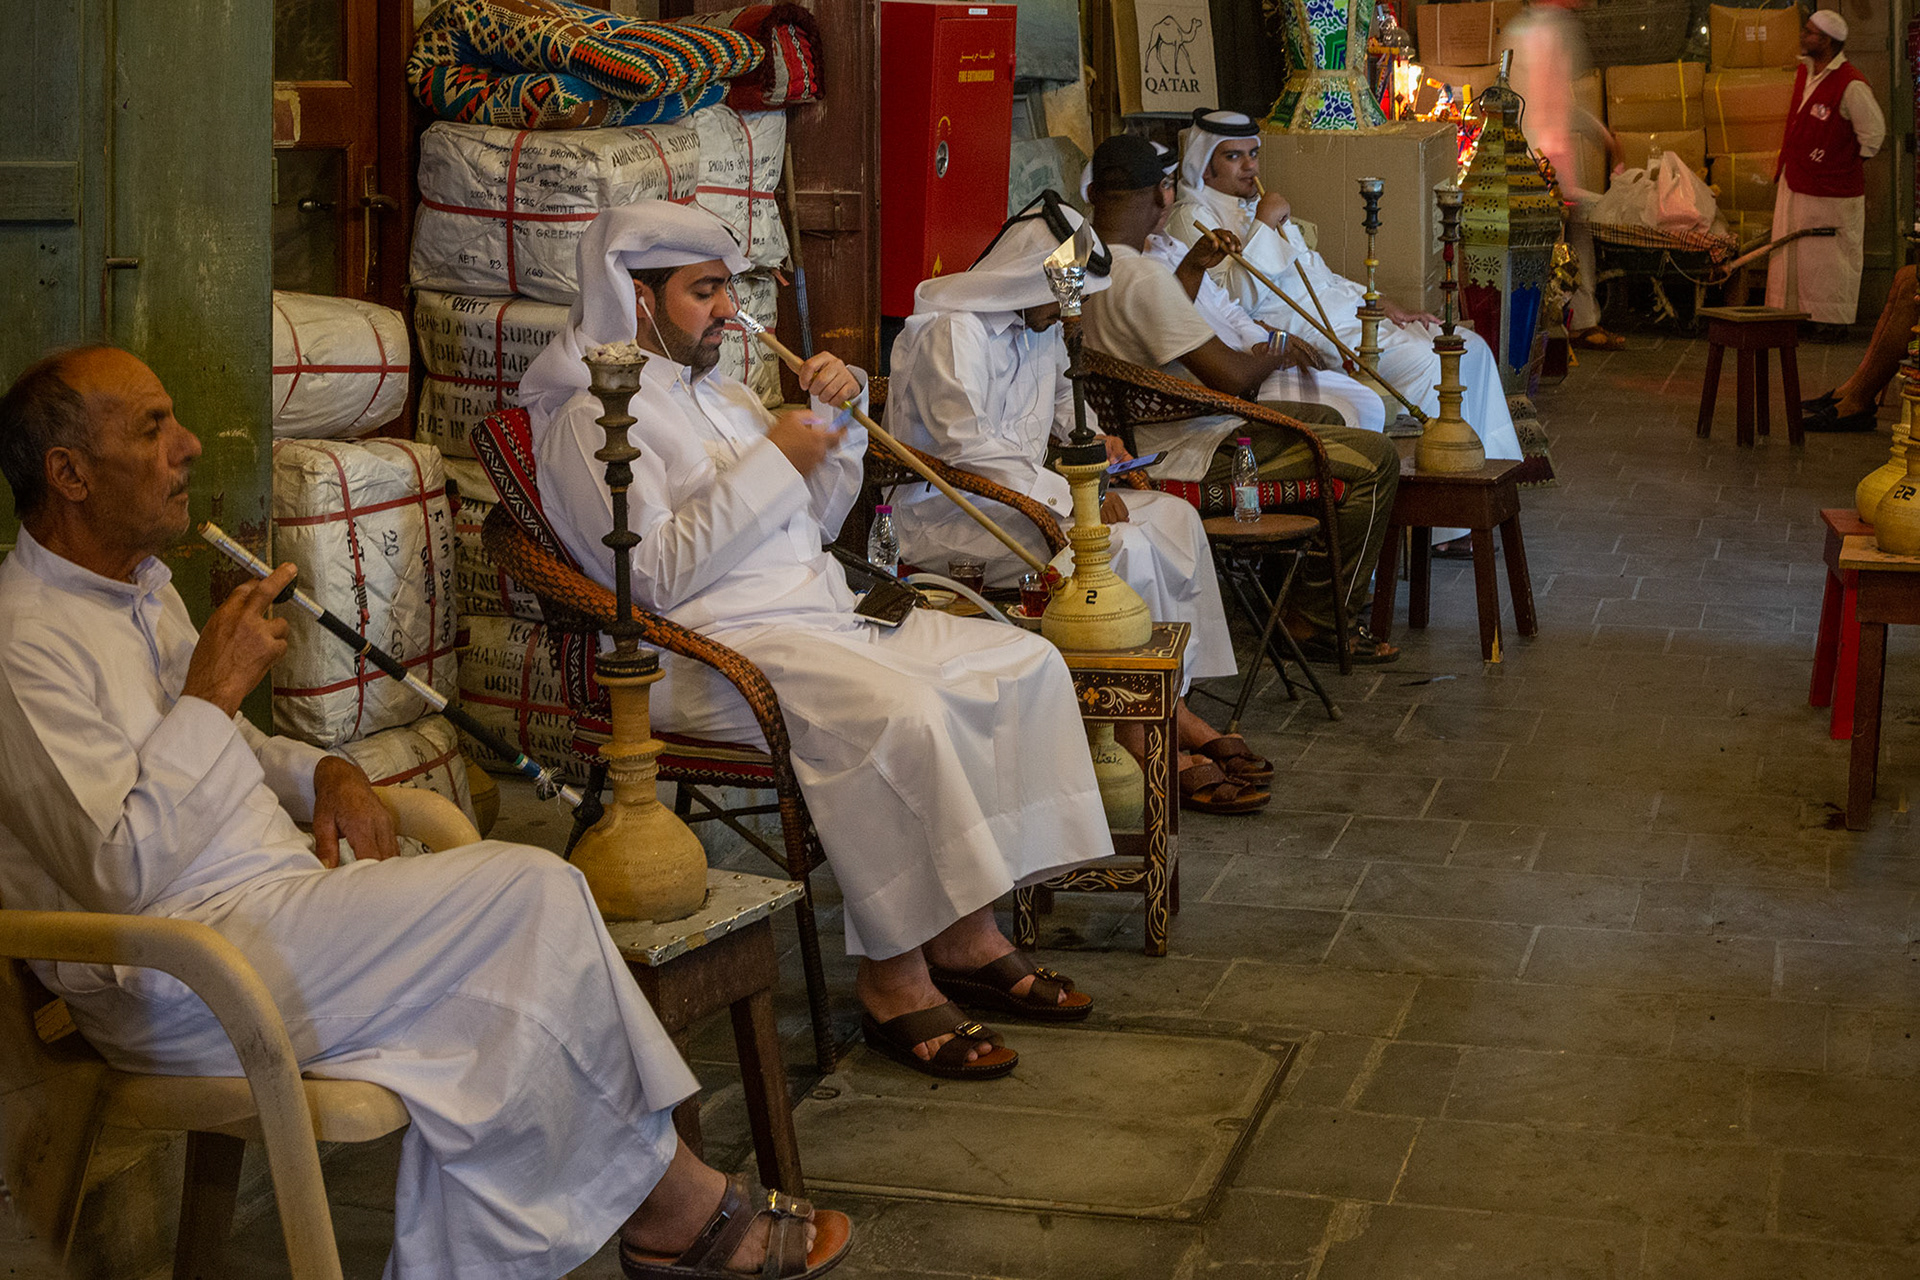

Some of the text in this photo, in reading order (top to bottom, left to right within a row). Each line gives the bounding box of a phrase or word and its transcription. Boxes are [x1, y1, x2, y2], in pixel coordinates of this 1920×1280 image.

[1144, 76, 1201, 95] QATAR
[1809, 147, 1825, 162] 42
[458, 254, 478, 266] NET
[1893, 484, 1917, 501] 22
[383, 529, 400, 557] 20
[1085, 590, 1098, 605] 2
